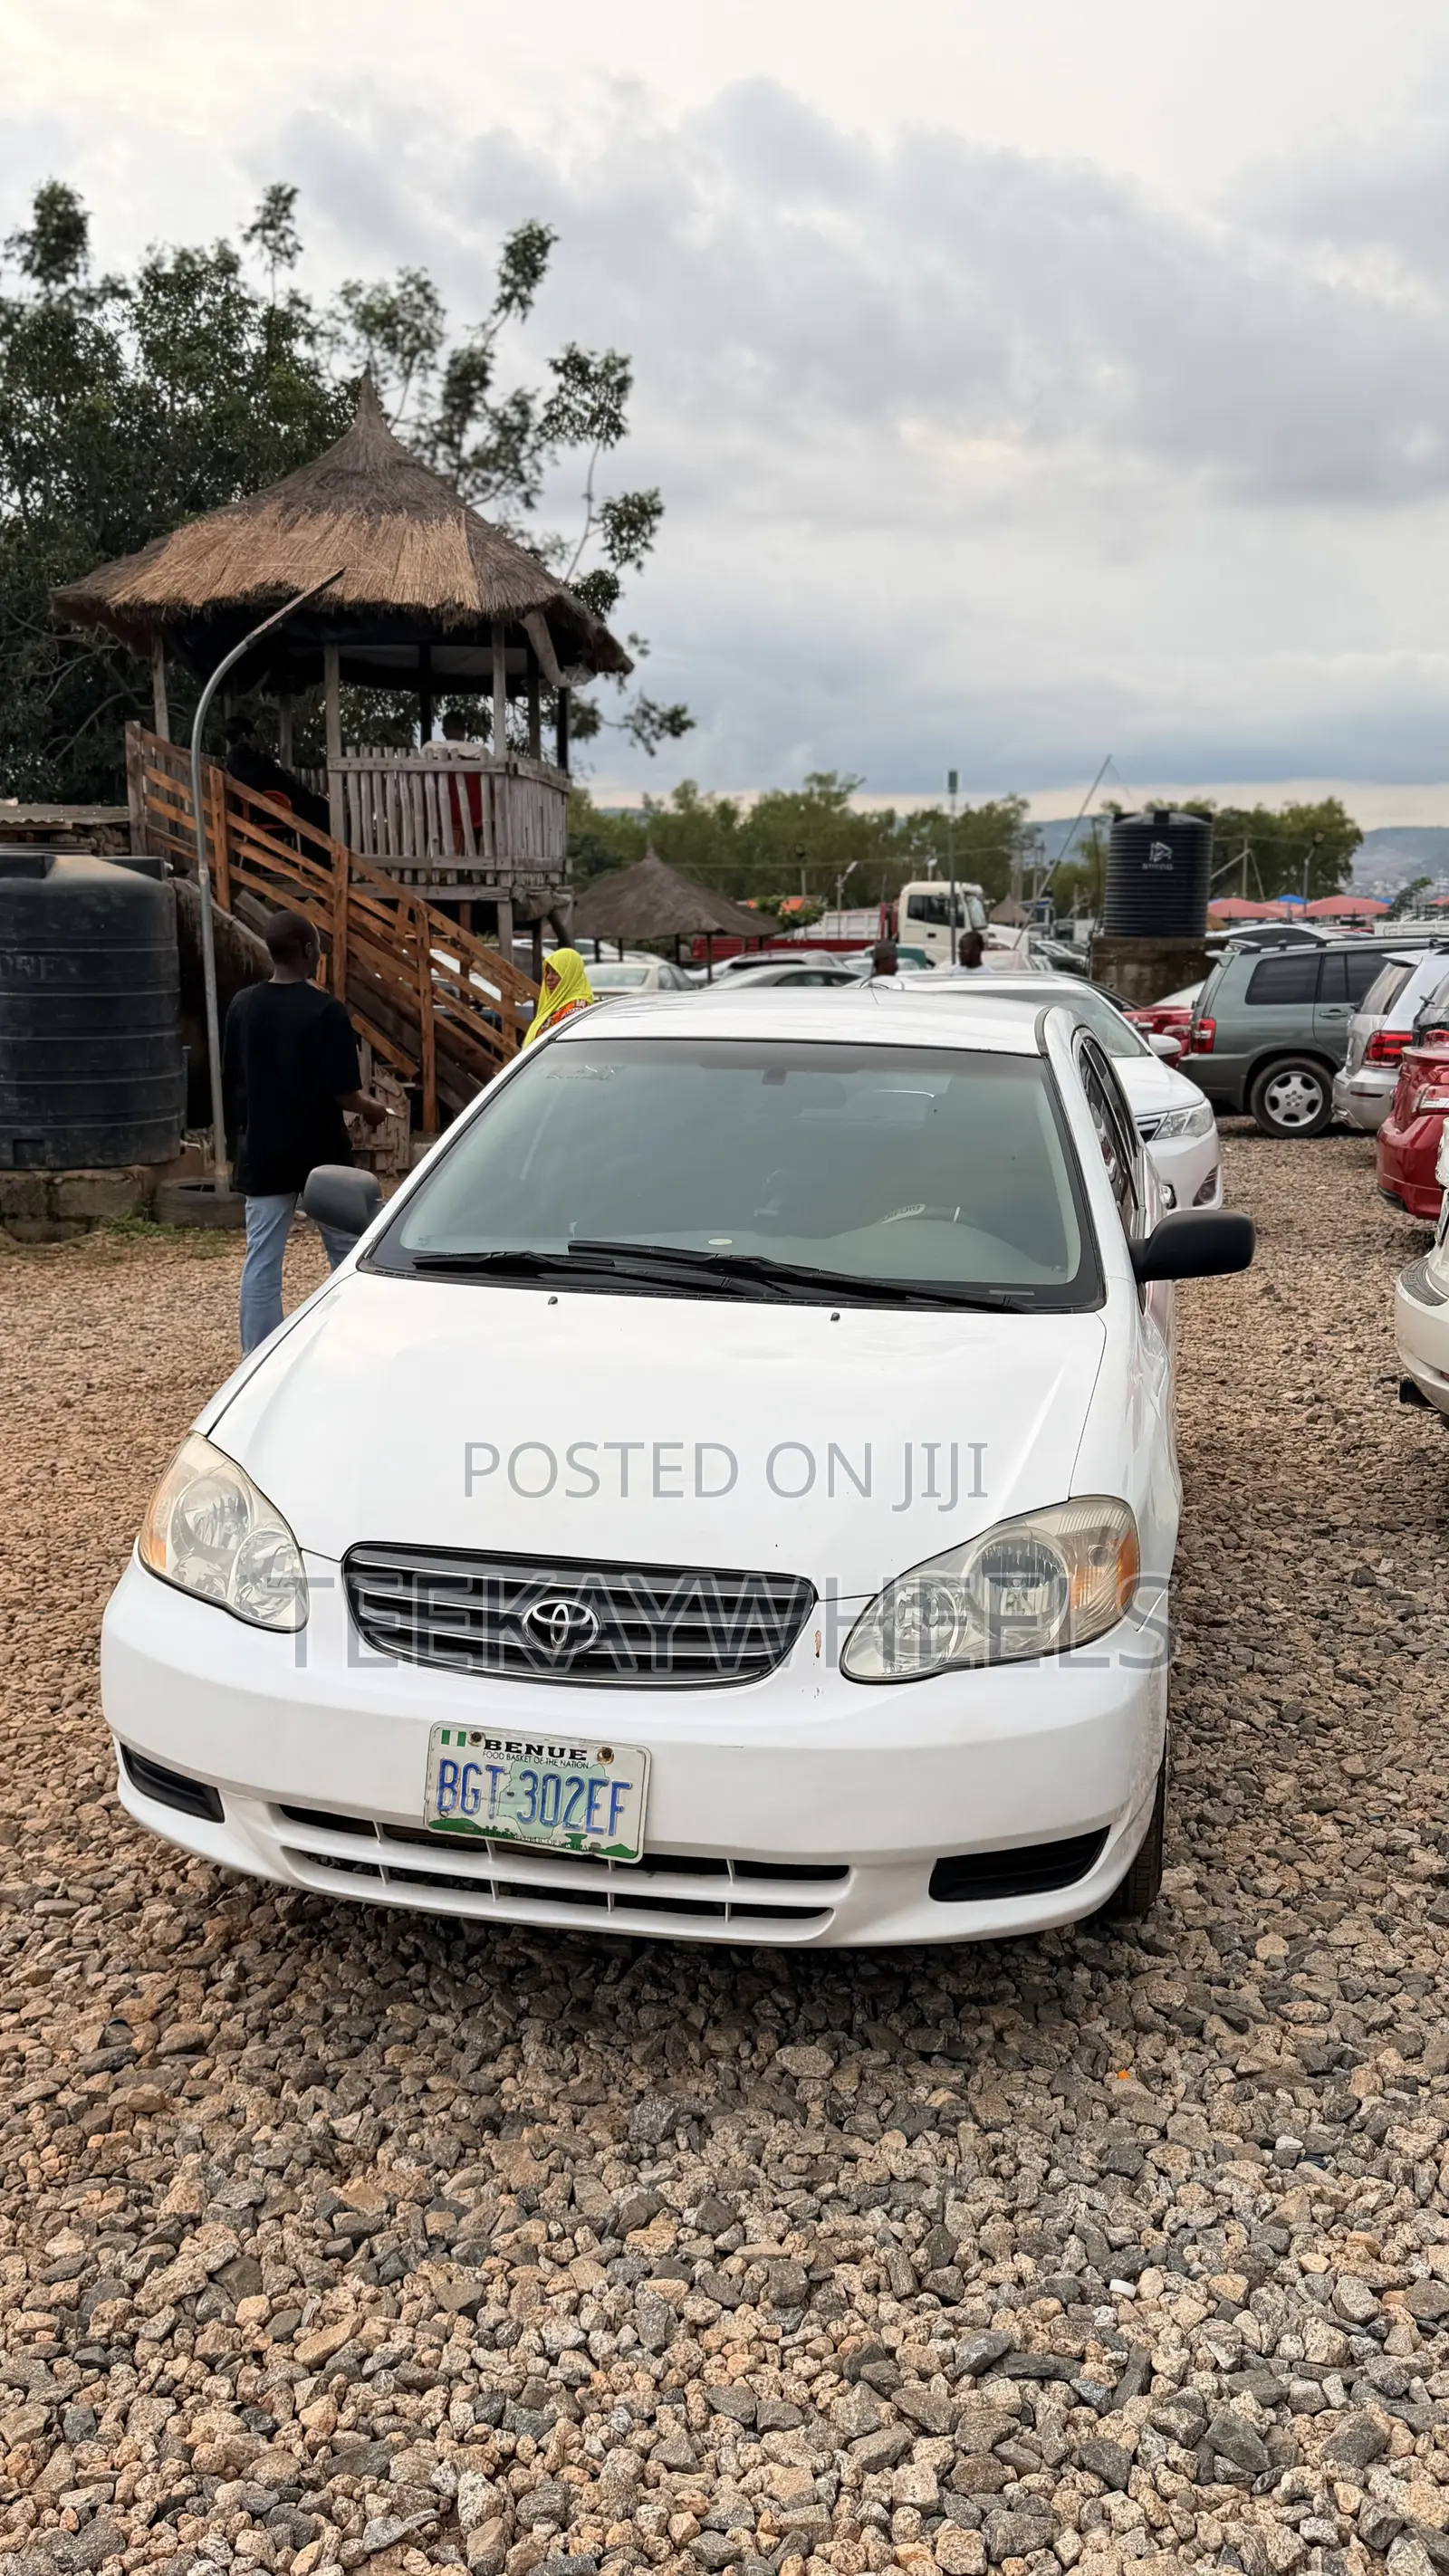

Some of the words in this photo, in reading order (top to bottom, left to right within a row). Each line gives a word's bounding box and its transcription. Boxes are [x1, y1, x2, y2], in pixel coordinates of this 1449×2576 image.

[483, 1750, 504, 1760] FOOD
[506, 1754, 532, 1763] BASKET
[533, 1756, 544, 1765] OF
[545, 1757, 558, 1766] THE
[560, 1759, 590, 1769] NATION
[484, 1739, 588, 1761] BENUE
